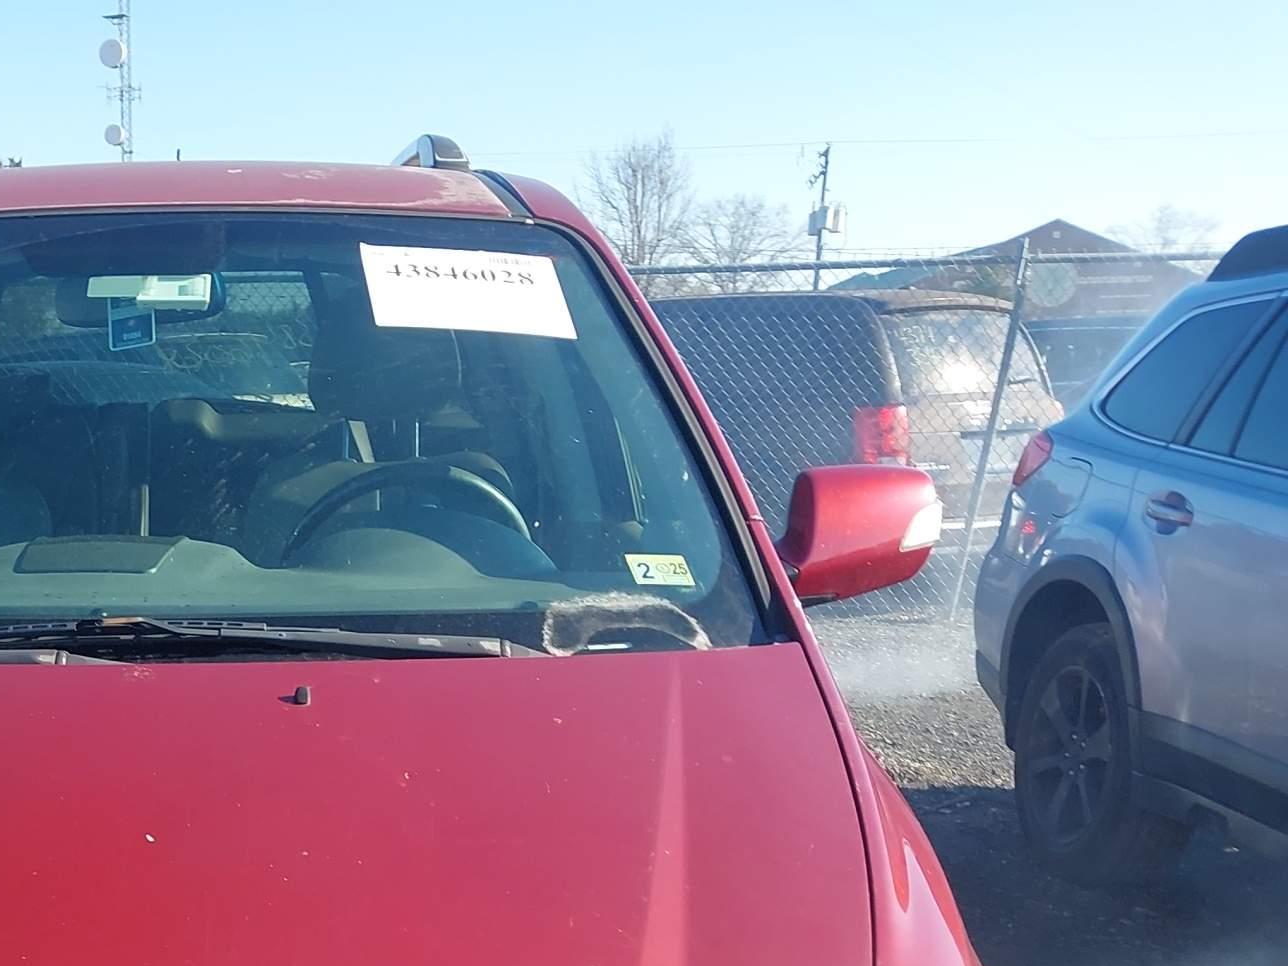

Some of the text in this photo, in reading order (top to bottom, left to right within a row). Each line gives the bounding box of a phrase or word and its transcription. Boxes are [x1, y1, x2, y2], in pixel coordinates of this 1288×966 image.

[386, 263, 535, 286] 43846028
[637, 562, 688, 579] 2 25
